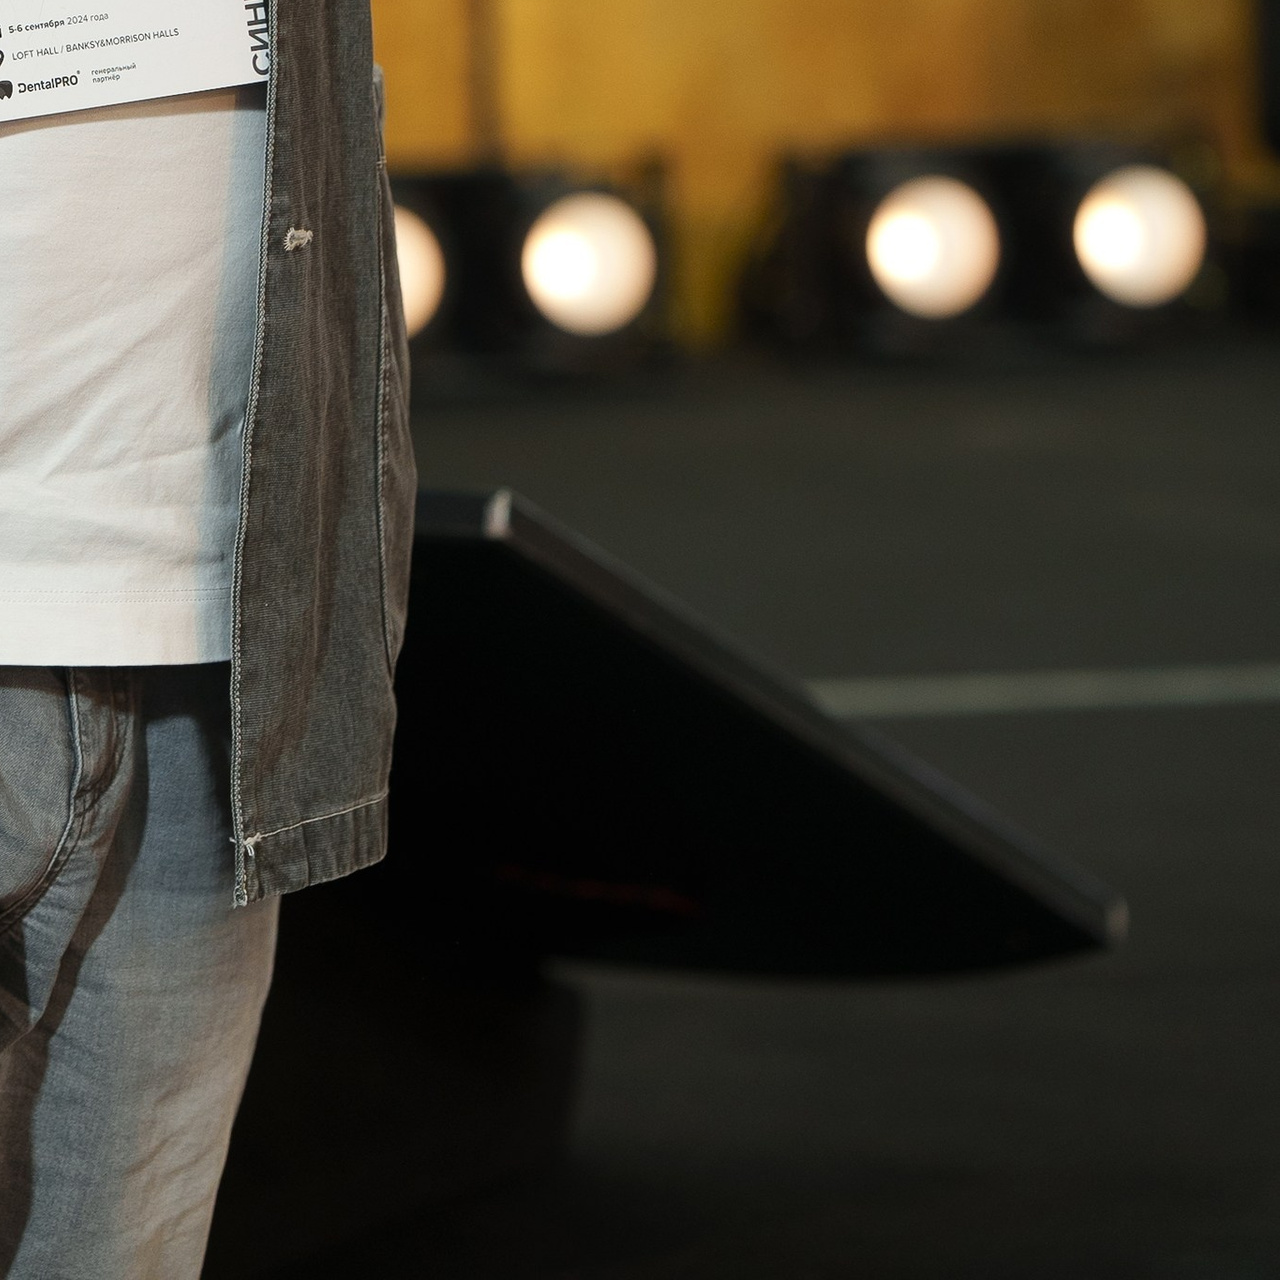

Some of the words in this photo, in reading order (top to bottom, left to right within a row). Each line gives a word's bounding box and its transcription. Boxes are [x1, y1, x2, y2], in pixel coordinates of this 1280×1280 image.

[24, 20, 65, 31] сентября
[67, 15, 88, 25] 2024
[90, 13, 109, 22] года
[12, 49, 34, 60] LOFT
[36, 46, 59, 56] HALL
[65, 32, 151, 53] BANKSY&MORRISON
[152, 28, 180, 41] HALLS
[91, 62, 136, 75] генеральный
